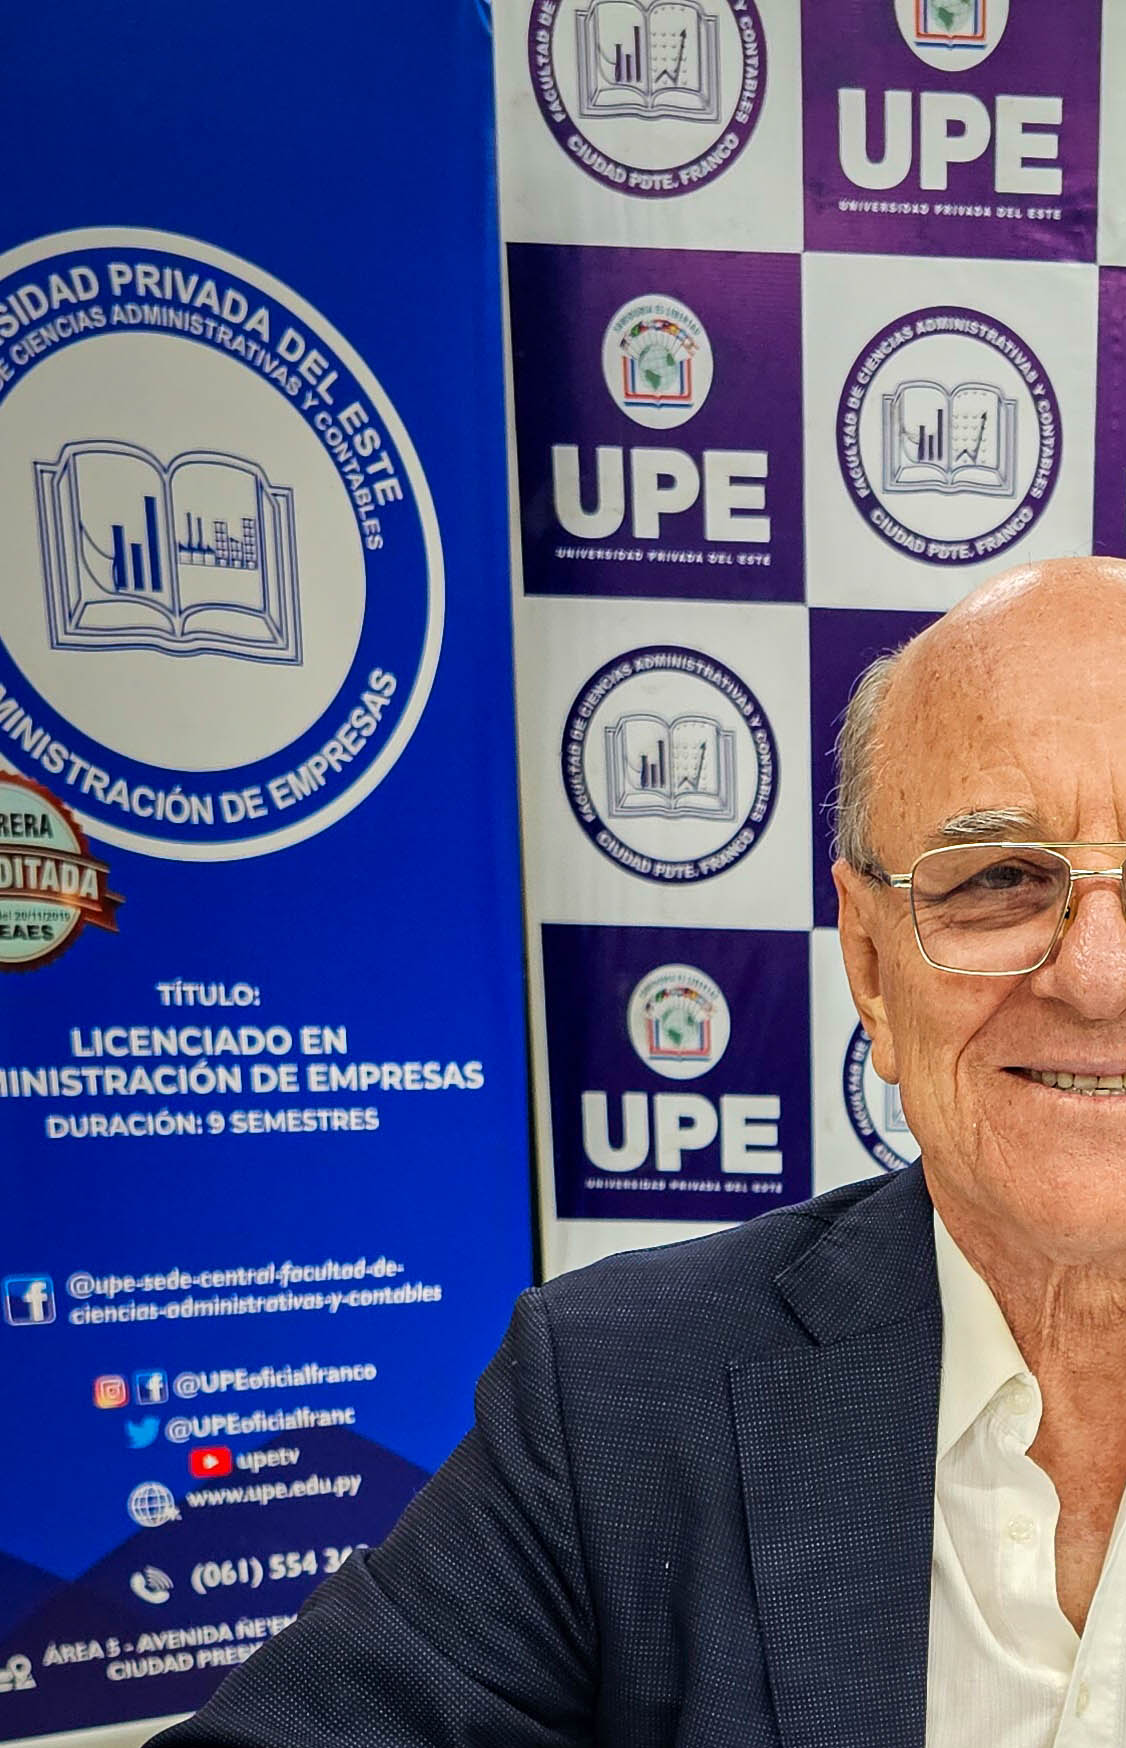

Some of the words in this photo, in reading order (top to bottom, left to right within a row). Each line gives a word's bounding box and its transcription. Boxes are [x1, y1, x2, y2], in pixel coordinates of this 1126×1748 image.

[839, 89, 1062, 195] UPE
[108, 261, 270, 342] PRIVADA
[277, 327, 338, 405] DEL
[337, 401, 403, 506] ESTE
[0, 358, 15, 391] E
[9, 305, 107, 366] CIENCIAS
[109, 302, 302, 396] ADMINISTRATIVAS
[302, 390, 319, 411] Y
[314, 411, 384, 551] CONTABLES
[554, 446, 770, 542] UPE
[219, 785, 268, 824] DE
[267, 667, 398, 811] EMPRESAS
[157, 978, 260, 1006] TÍTULO:
[70, 1026, 292, 1057] LICENCIADO
[300, 1025, 347, 1054] EN
[251, 1063, 299, 1093] DE
[307, 1061, 485, 1092] EMPRESAS
[46, 1107, 203, 1138] DURACIÓN:
[206, 1111, 225, 1134] 9
[230, 1107, 380, 1134] SEMESTRES
[582, 1092, 782, 1174] UPE
[173, 1363, 377, 1398] @UPEoficialfranco
[165, 1406, 356, 1443] @UPEoficialfranc
[236, 1448, 300, 1473] upetv
[185, 1474, 361, 1507] www.upe.edu.py
[191, 1556, 263, 1595] (061)
[269, 1550, 318, 1580] 554
[42, 1640, 104, 1666] ÁREA
[136, 1622, 233, 1653] AVENIDA
[107, 1652, 195, 1681] CIUDAD
